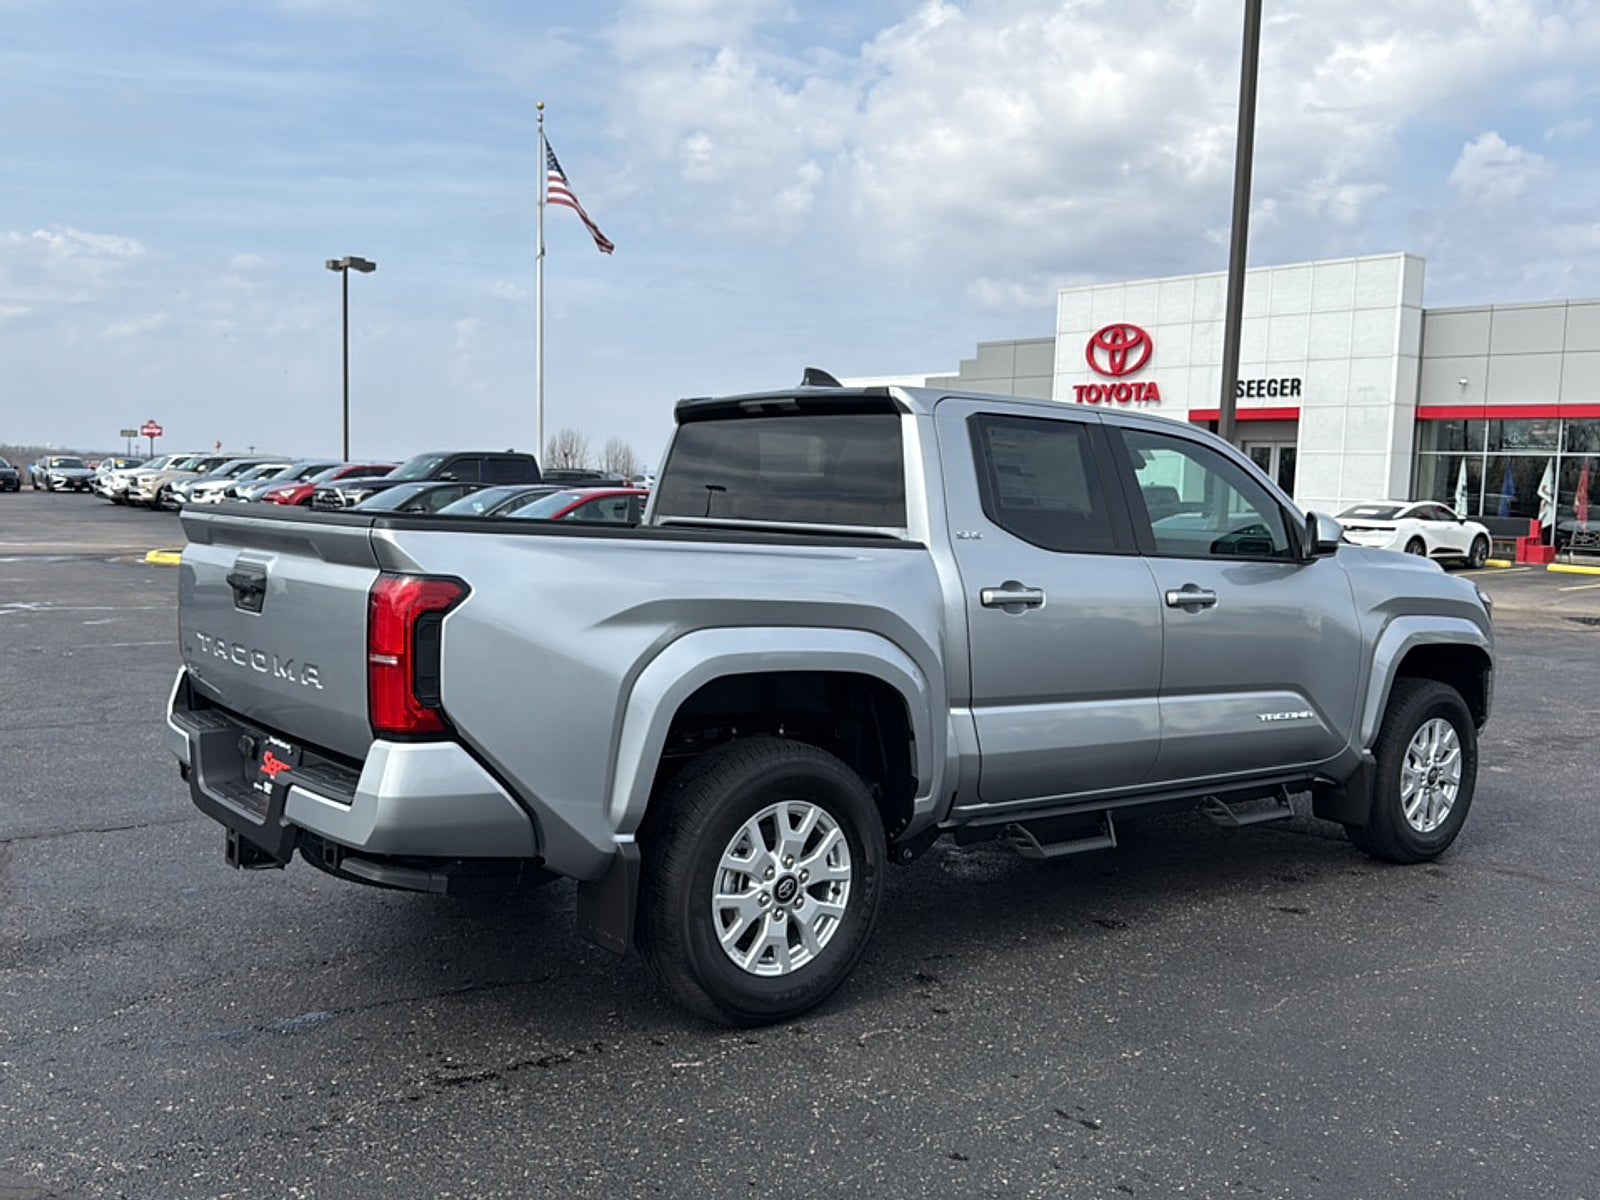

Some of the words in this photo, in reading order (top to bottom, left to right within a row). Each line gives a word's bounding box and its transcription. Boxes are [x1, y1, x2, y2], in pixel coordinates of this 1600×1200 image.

[1073, 382, 1160, 404] TOYOTA
[1236, 378, 1301, 398] SEEGER
[197, 632, 323, 690] TACOMA
